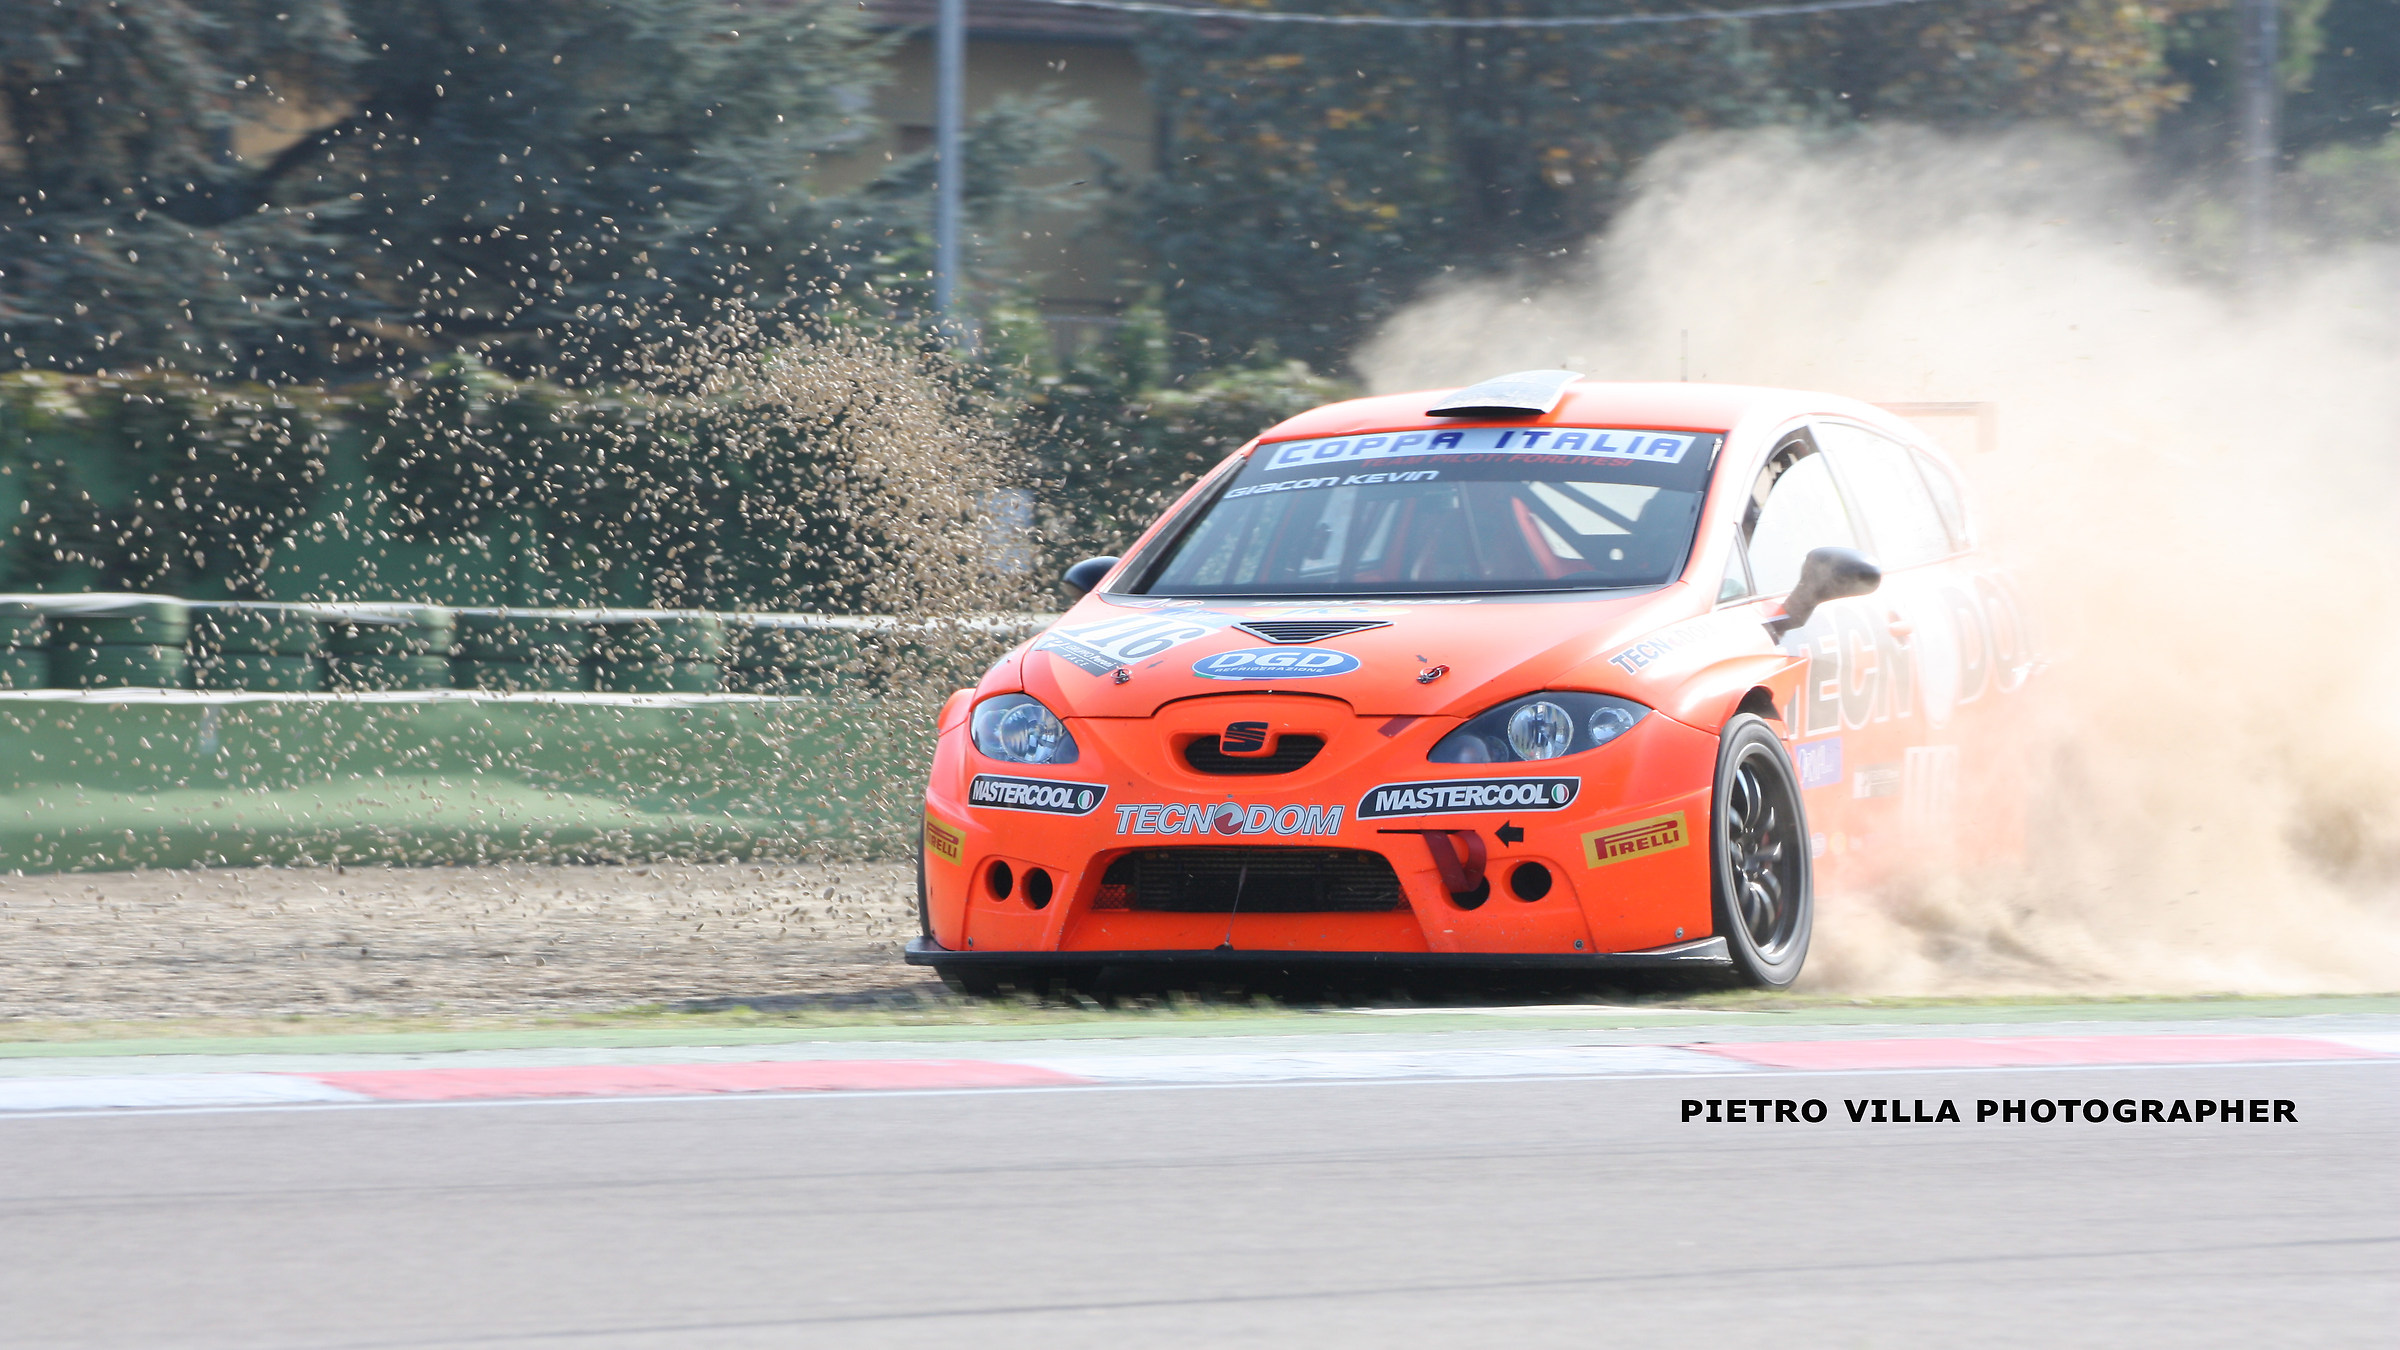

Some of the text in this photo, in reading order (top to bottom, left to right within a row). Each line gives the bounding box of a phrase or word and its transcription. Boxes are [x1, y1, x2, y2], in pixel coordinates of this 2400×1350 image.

[1278, 430, 1682, 464] COPPA ITALIA
[1360, 454, 1422, 468] TEAM
[1058, 615, 1206, 659] 116
[1208, 652, 1345, 668] DGD
[972, 780, 1076, 809] MASTERCOOL
[1375, 782, 1550, 812] MASTERCOOL
[1593, 820, 1680, 860] PIRELLI
